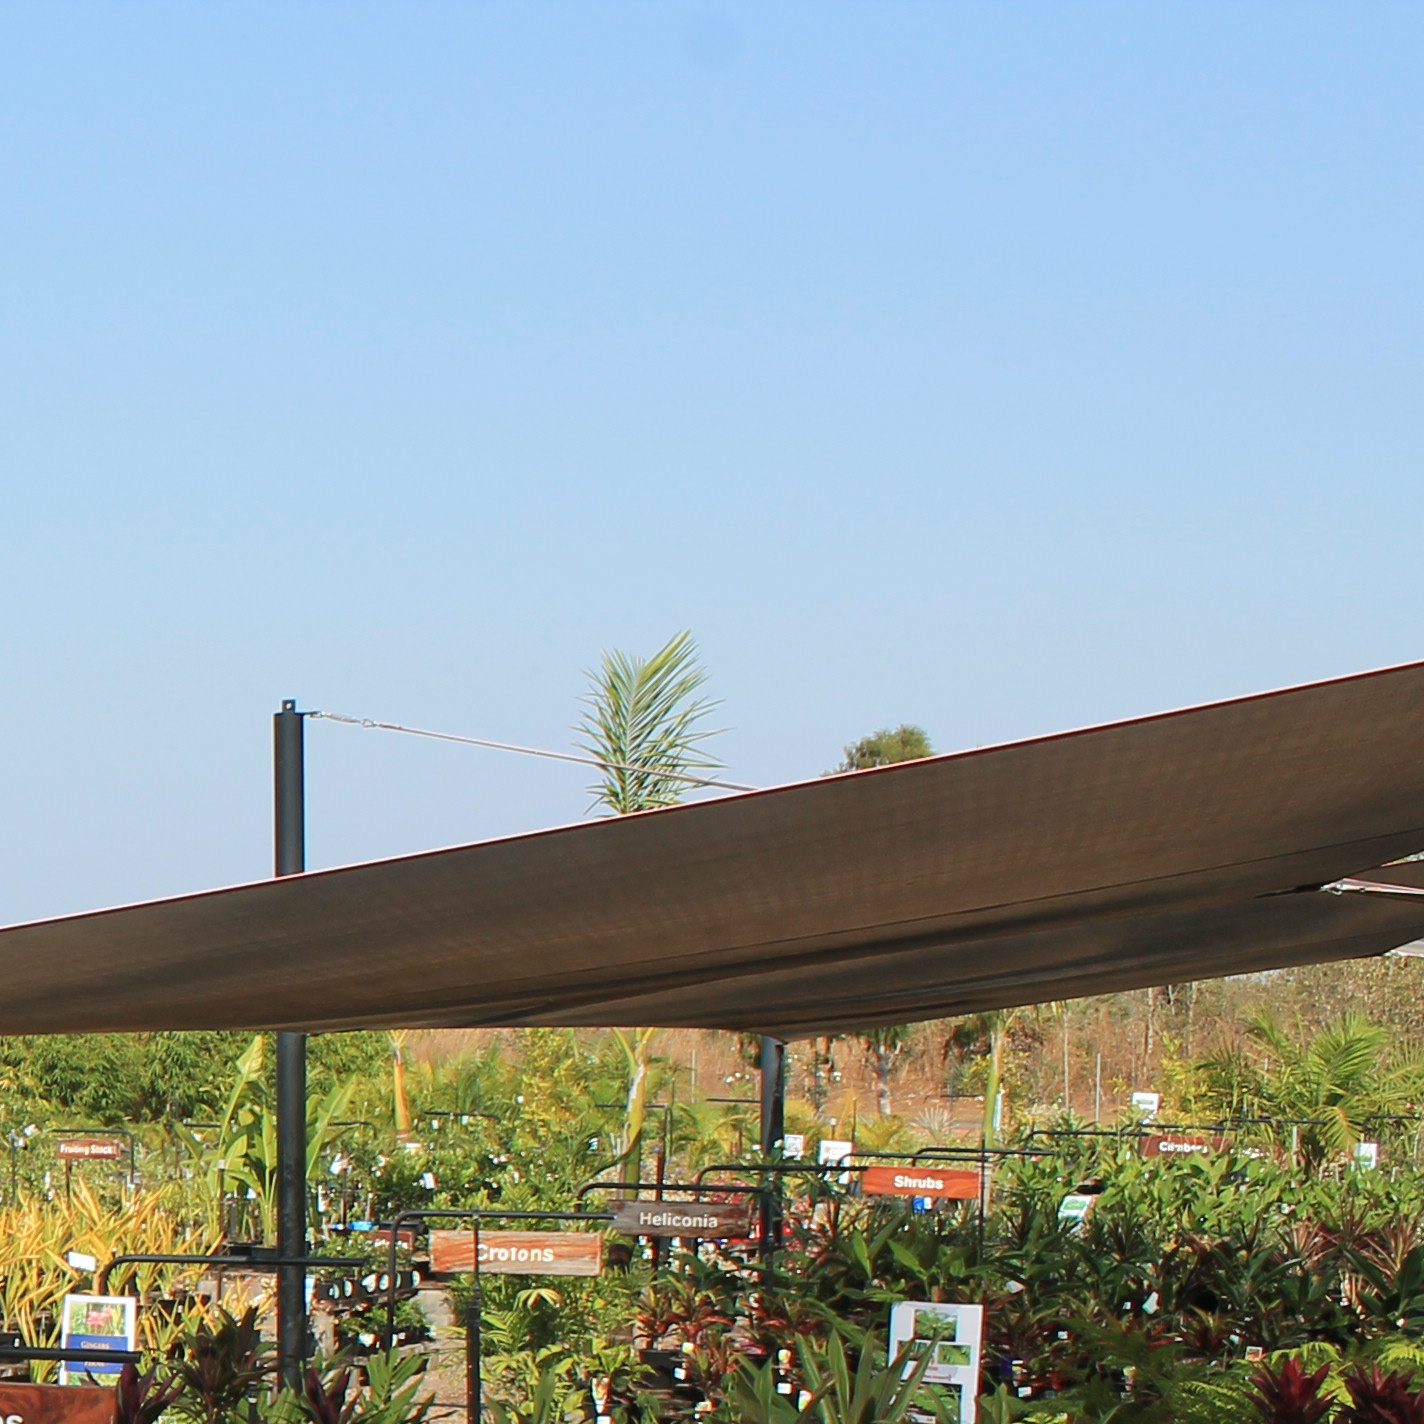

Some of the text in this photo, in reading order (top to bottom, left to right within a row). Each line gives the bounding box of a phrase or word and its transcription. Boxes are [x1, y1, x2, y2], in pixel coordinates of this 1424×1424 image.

[60, 1143, 90, 1156] Fruiting
[893, 1175, 945, 1190] Shrubs
[639, 1211, 718, 1228] Heliconia
[476, 1243, 554, 1262] Crotons
